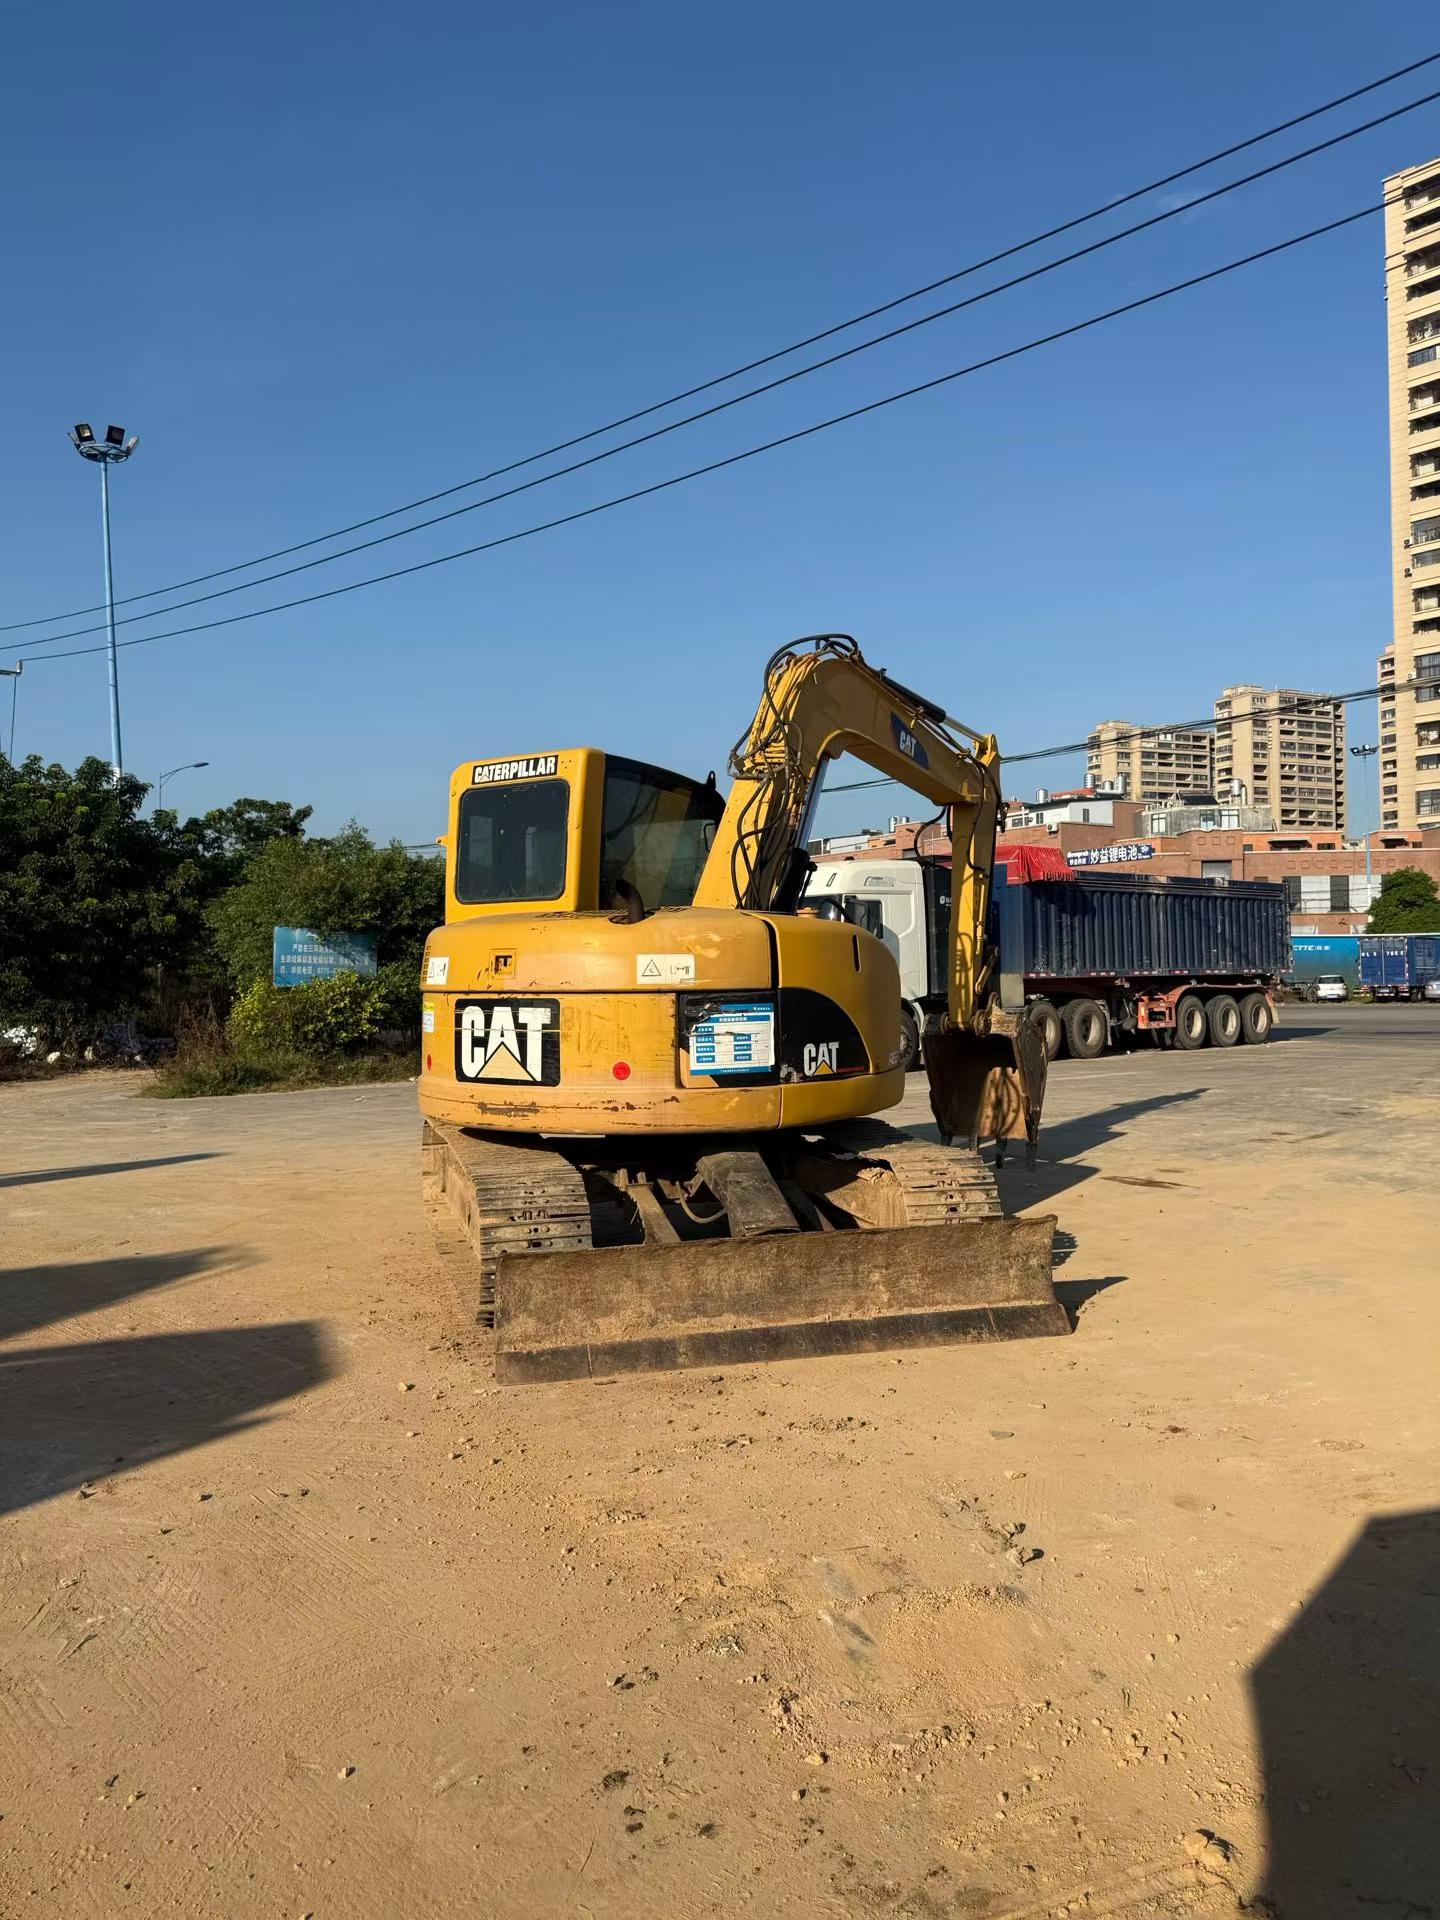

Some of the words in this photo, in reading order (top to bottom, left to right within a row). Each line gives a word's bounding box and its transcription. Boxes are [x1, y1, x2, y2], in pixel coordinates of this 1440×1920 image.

[900, 730, 917, 758] CAT
[474, 756, 556, 784] CATERPILLAR
[1090, 845, 1138, 864] 妙益锂电池
[461, 1005, 551, 1082] CAT
[803, 1041, 840, 1077] CAT
